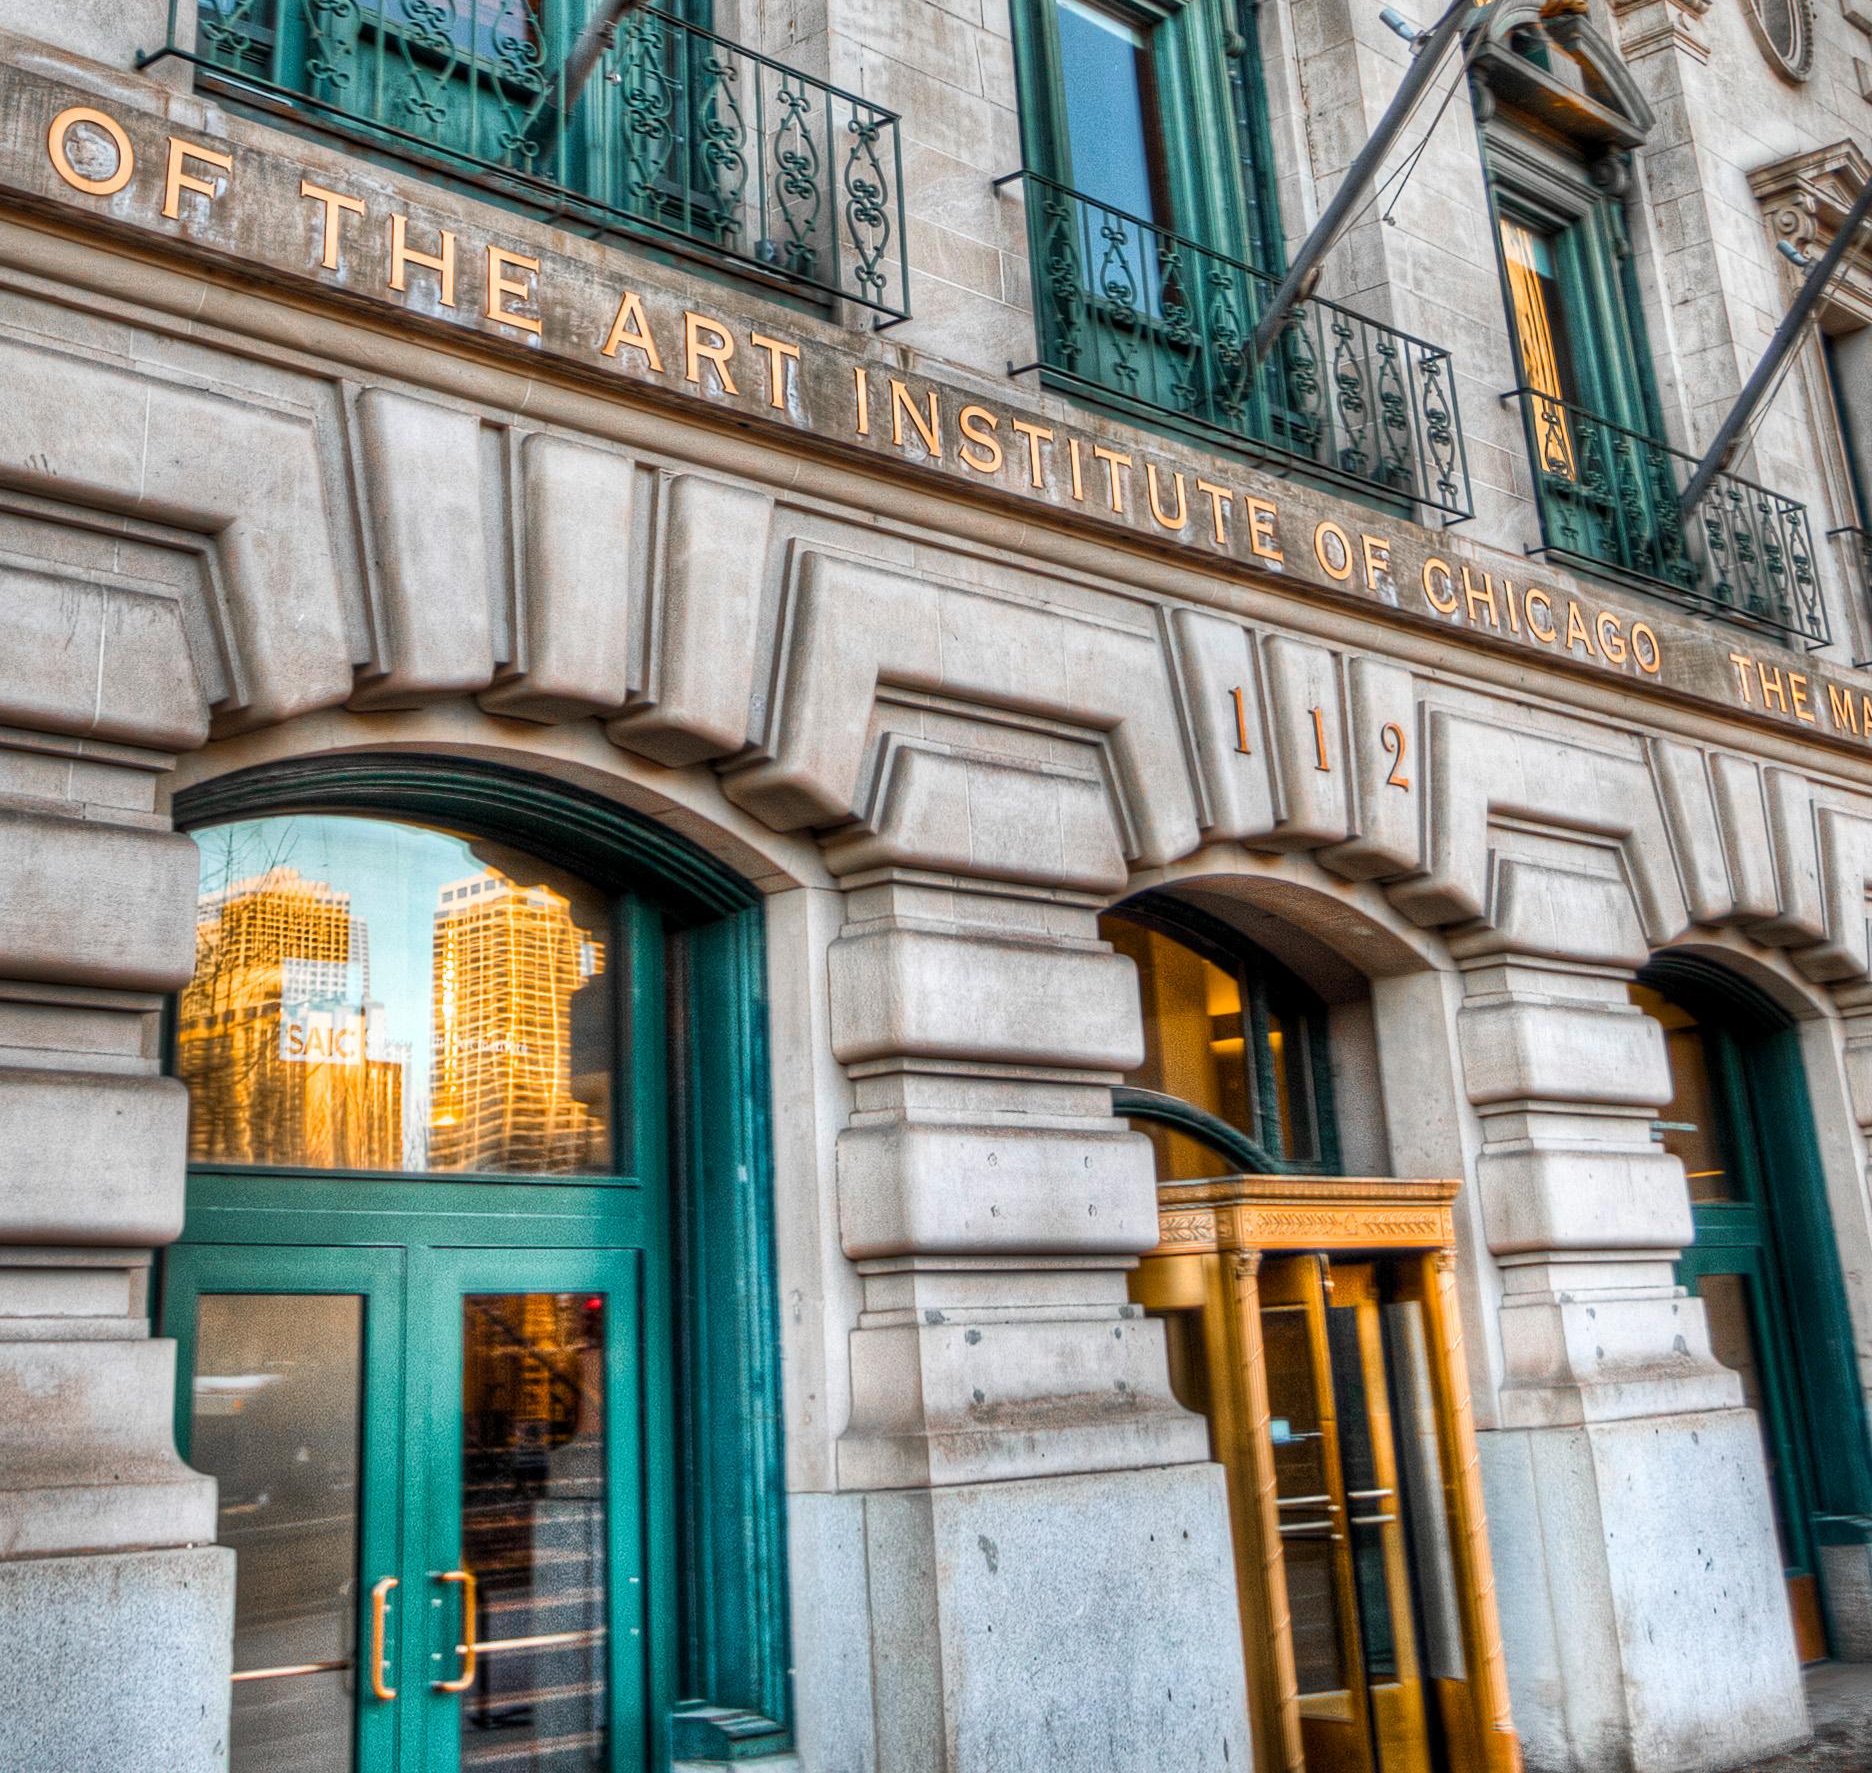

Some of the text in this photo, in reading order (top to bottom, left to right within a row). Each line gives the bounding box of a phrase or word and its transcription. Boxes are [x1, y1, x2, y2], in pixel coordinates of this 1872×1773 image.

[47, 107, 233, 220] OF
[299, 179, 543, 336] THE
[601, 290, 800, 410] ART
[854, 366, 1285, 564] INSTITUTE
[1313, 520, 1391, 591] OF
[1422, 557, 1661, 674] CHICAGO
[1729, 652, 1815, 723] THE
[285, 1023, 358, 1059] SAIC
